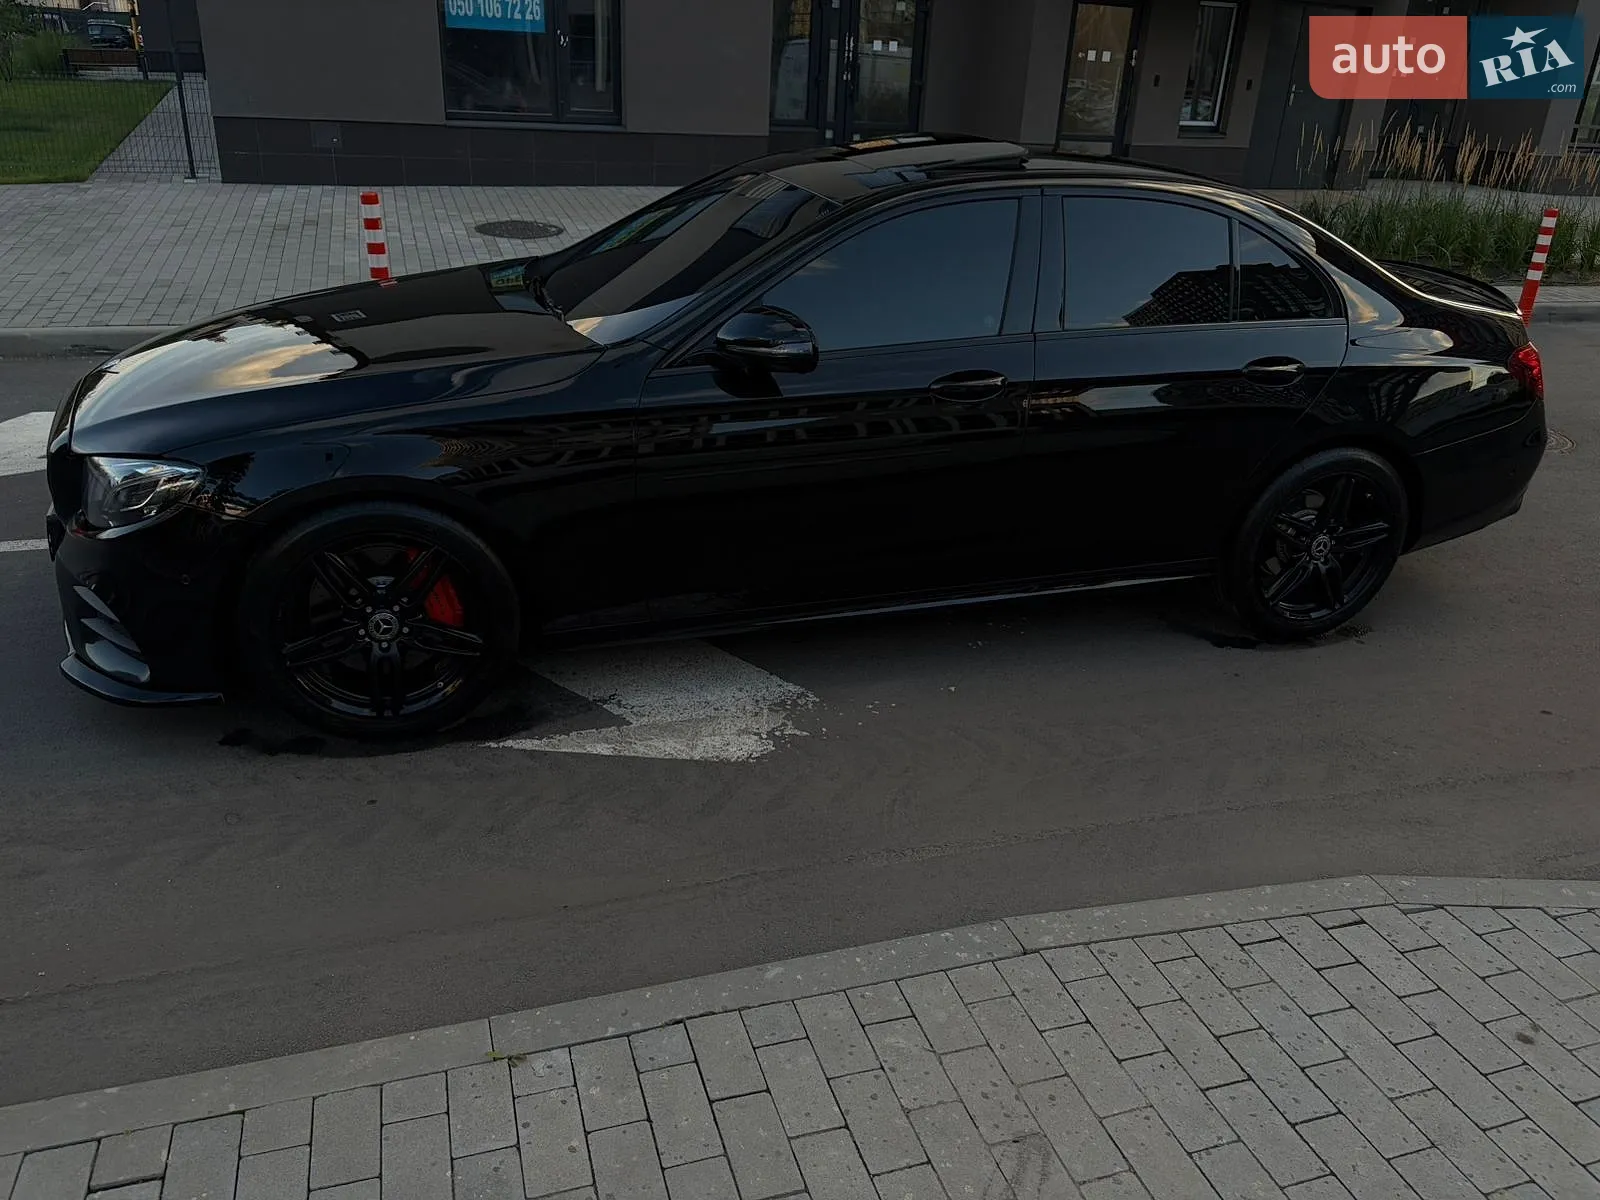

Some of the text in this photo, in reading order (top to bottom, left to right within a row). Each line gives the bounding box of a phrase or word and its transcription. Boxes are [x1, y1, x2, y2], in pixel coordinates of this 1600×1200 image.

[448, 0, 541, 20] 050 106 72 26
